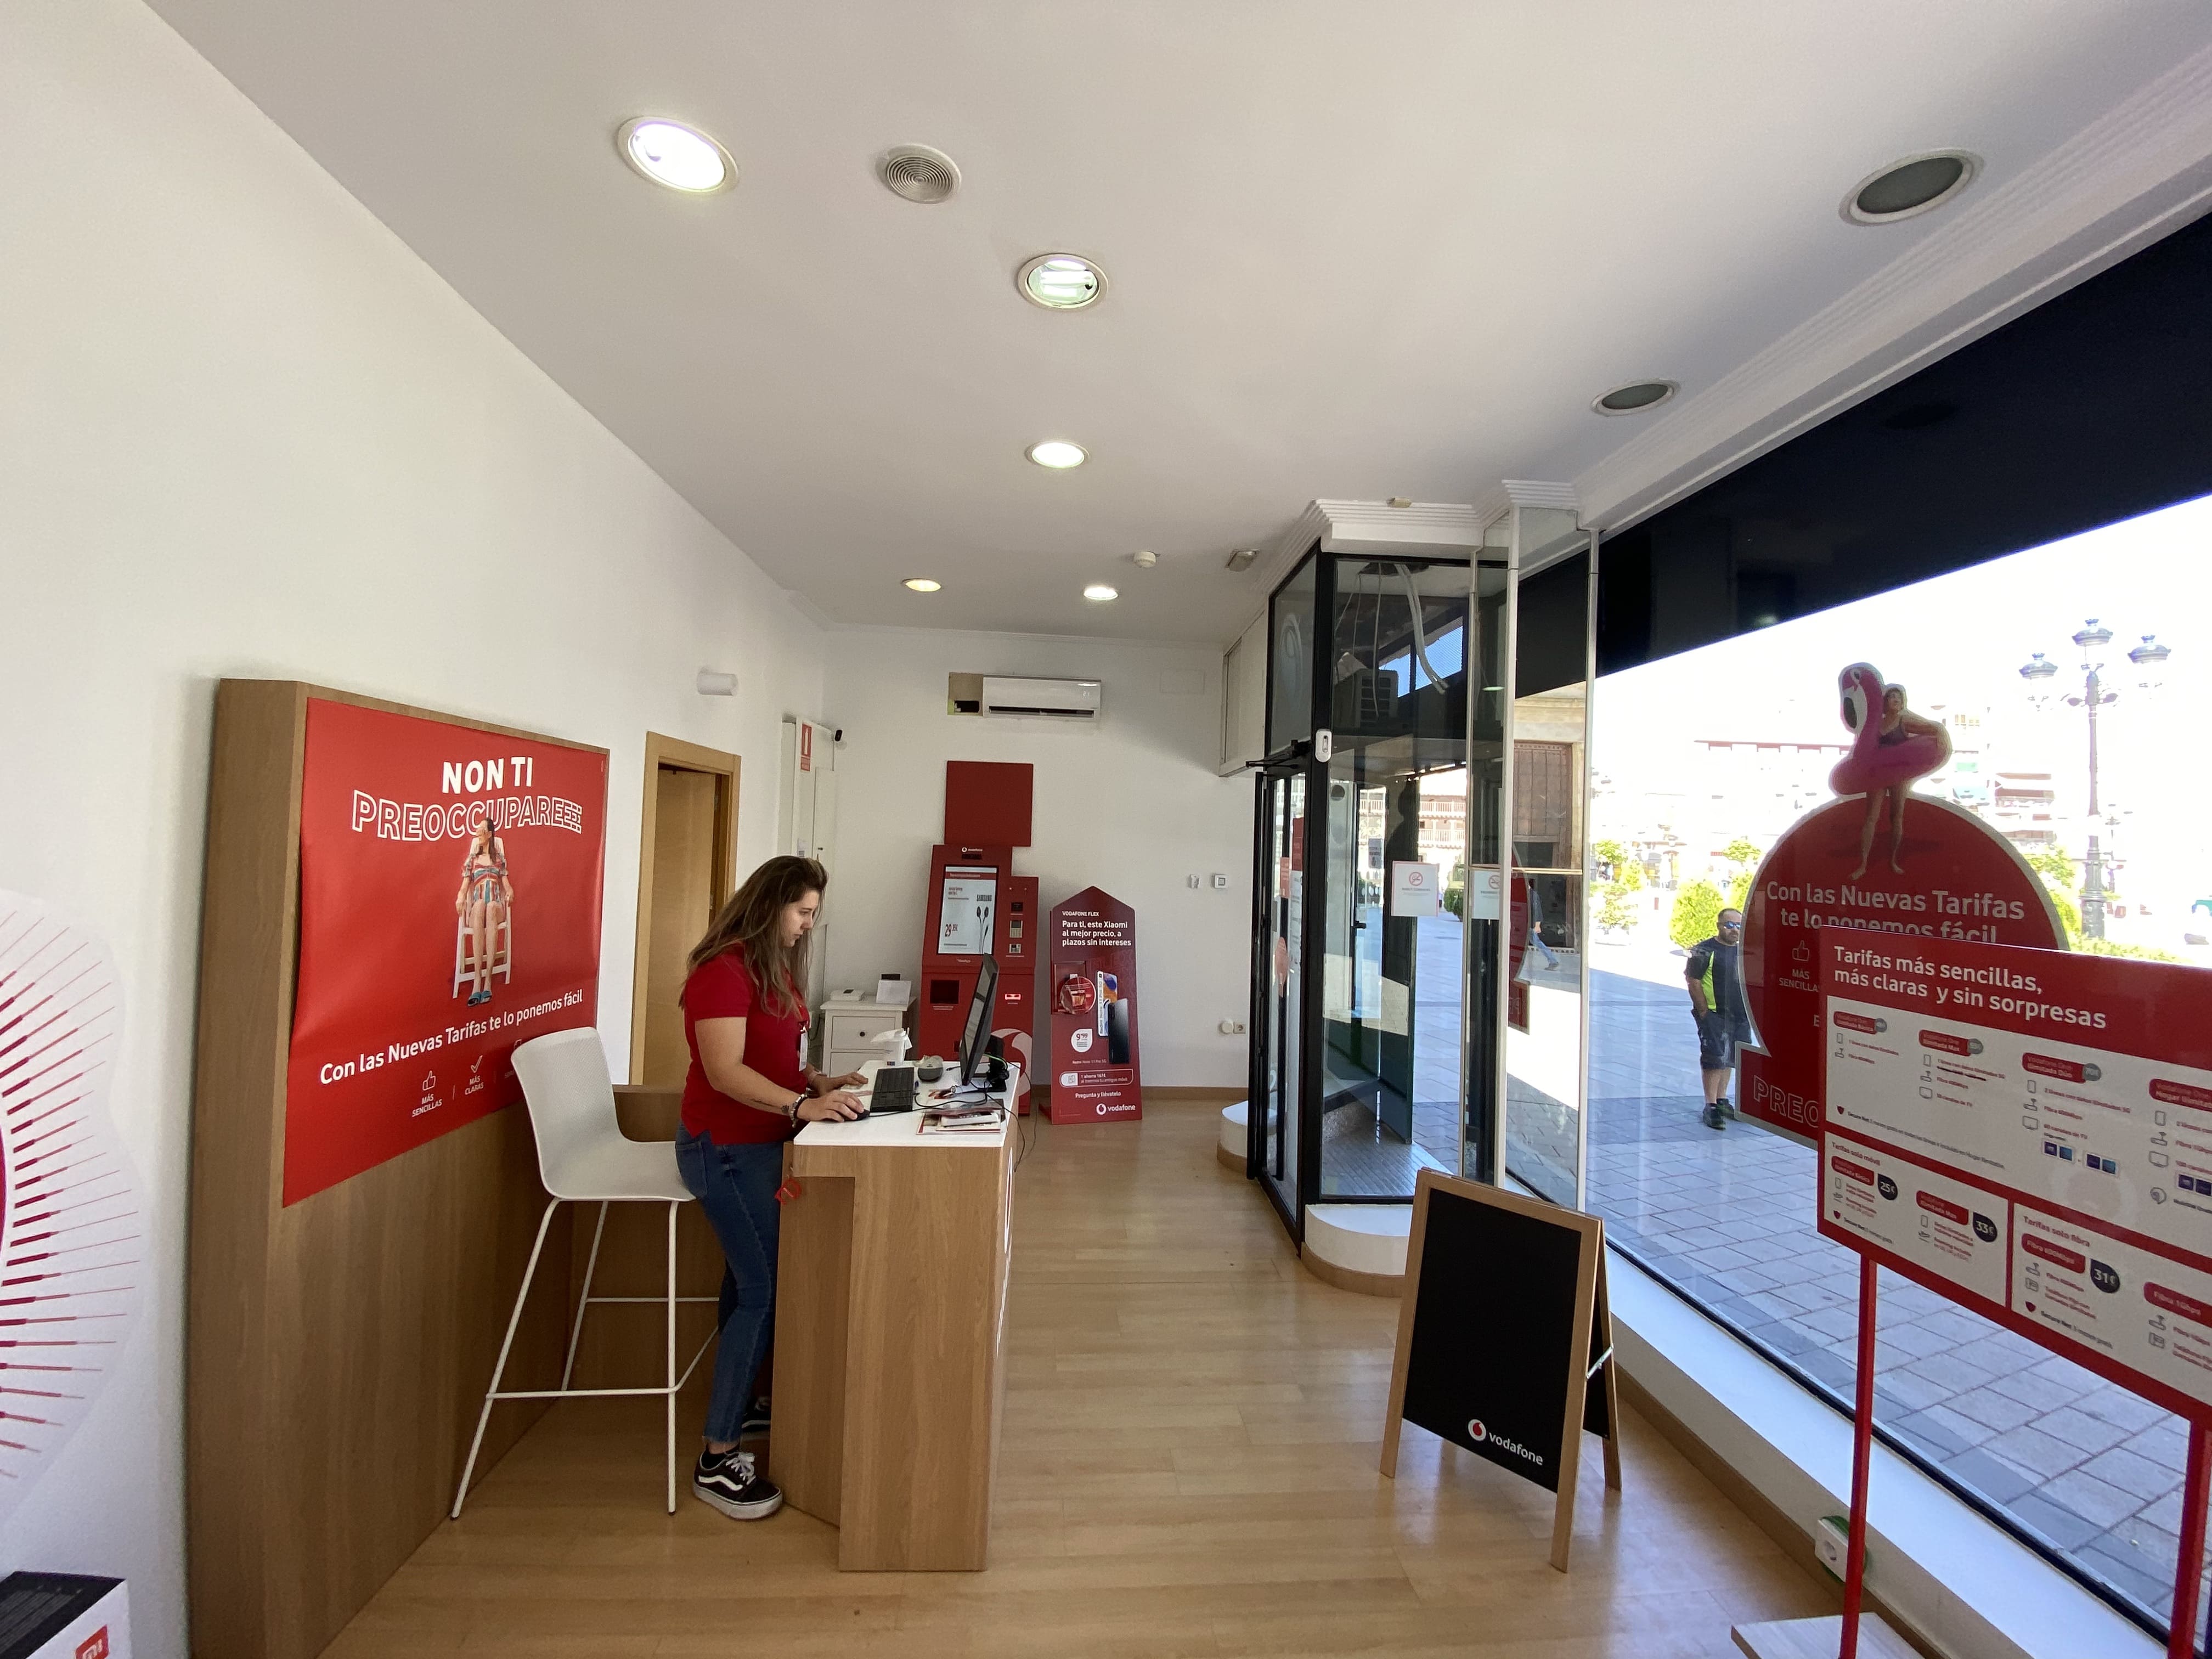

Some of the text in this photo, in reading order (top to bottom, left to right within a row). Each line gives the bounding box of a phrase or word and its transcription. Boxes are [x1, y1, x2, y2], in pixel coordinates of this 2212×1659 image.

[442, 756, 533, 794] NON TI
[1767, 881, 2025, 920] Con las Nuevas Tarifas
[1780, 909, 1799, 927] te
[1804, 909, 1822, 929] lo
[1062, 939, 1086, 947] plazos
[1071, 930, 1091, 938] mejor
[1834, 946, 2043, 995] Tarifas más sencillas,
[1834, 968, 2106, 1029] más claras y sin sorpresas
[320, 989, 583, 1085] Con las Nuevas Tarifas te lo ponemos fácil
[465, 1082, 484, 1095] CLARAS
[469, 1076, 481, 1085] MÁS
[412, 1099, 442, 1117] SENCILLAS
[421, 1093, 434, 1104] MÁS
[1832, 1142, 1850, 1154] Tarifas
[1851, 1150, 1863, 1159] solo
[1864, 1155, 1881, 1166] móvil
[1880, 1181, 1895, 1194] 25€
[1975, 1221, 1994, 1235] 33€
[2023, 1215, 2090, 1247] Tarifas solo fibra
[2094, 1268, 2116, 1285] 31€
[1489, 1432, 1543, 1466] vodafone
